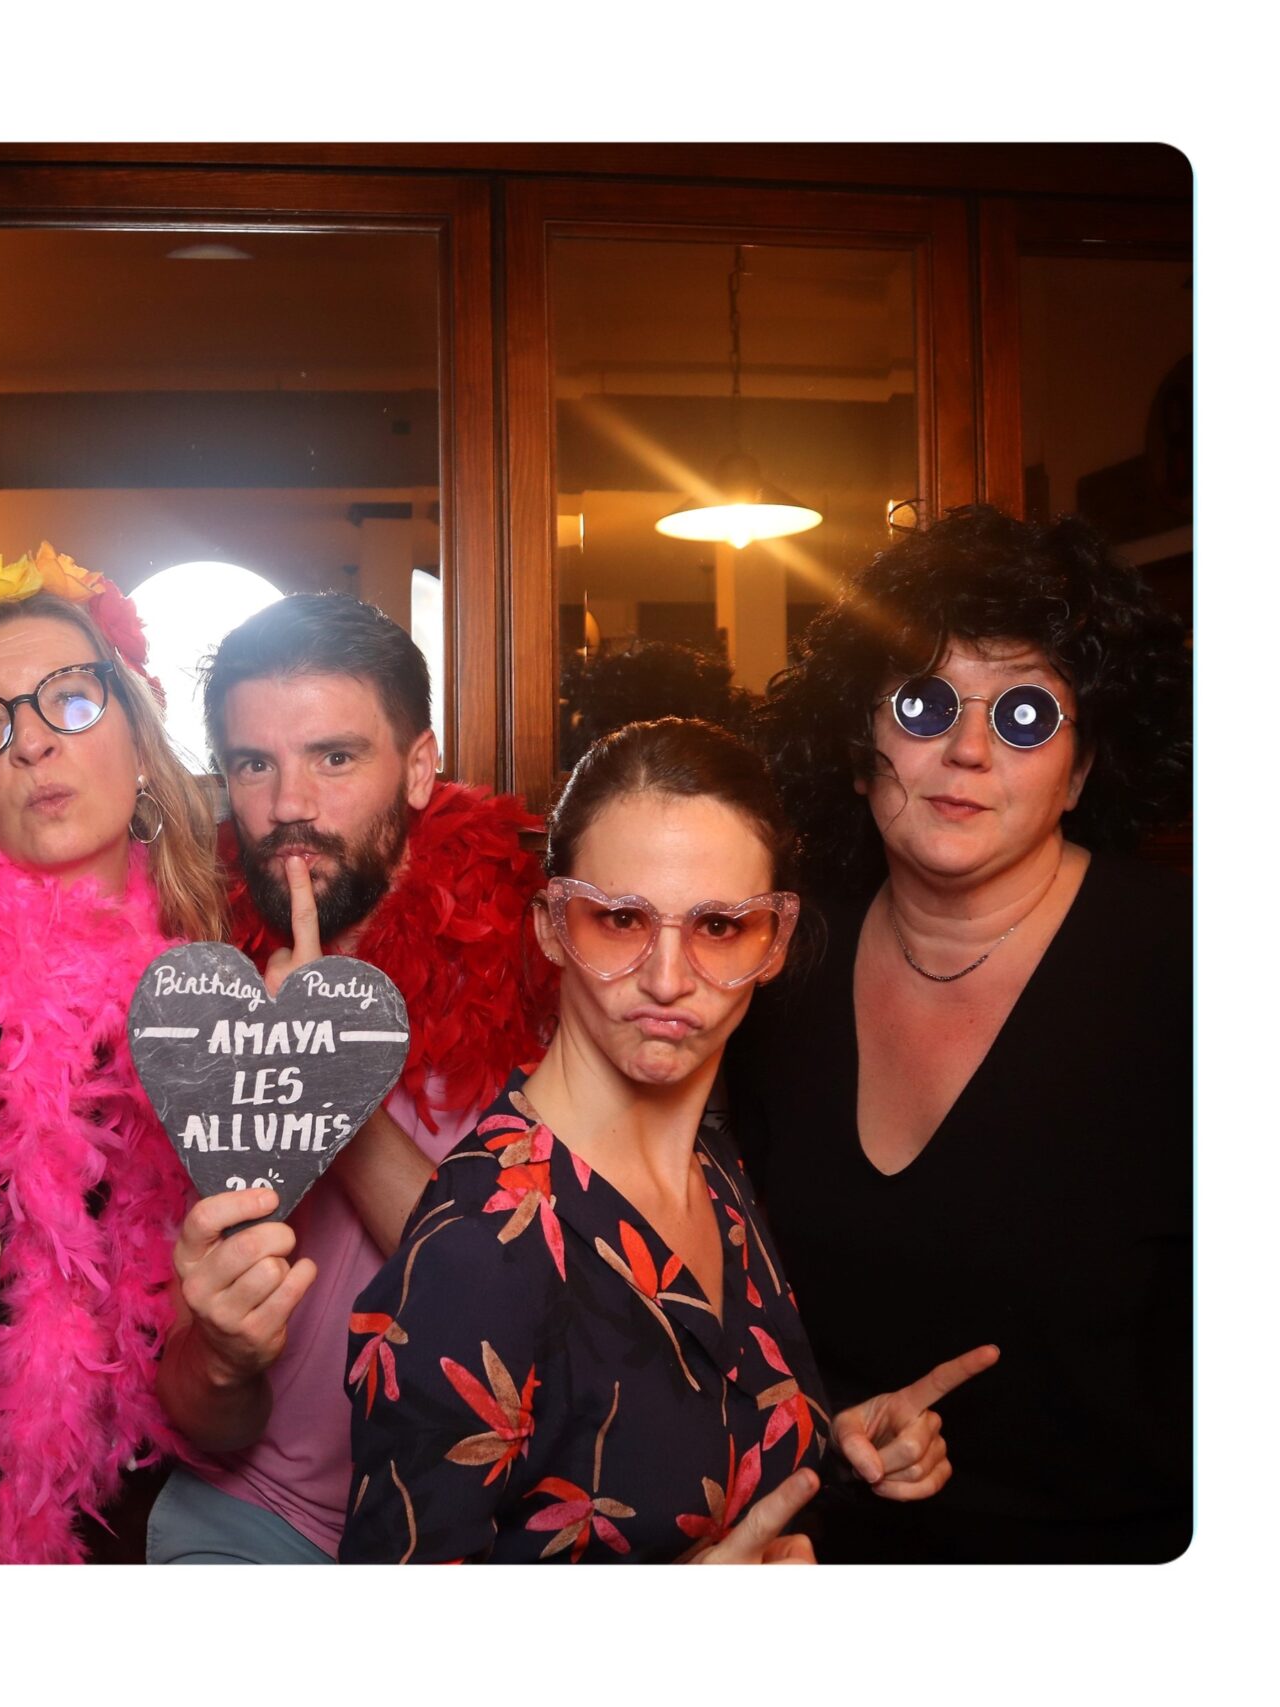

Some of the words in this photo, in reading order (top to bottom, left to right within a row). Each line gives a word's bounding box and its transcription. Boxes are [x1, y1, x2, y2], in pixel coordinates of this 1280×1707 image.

[154, 965, 266, 1012] Birthday
[302, 970, 378, 1010] Party
[207, 1019, 336, 1055] AMAYA
[231, 1066, 304, 1105] LES
[178, 1102, 353, 1152] ALLUMÉS
